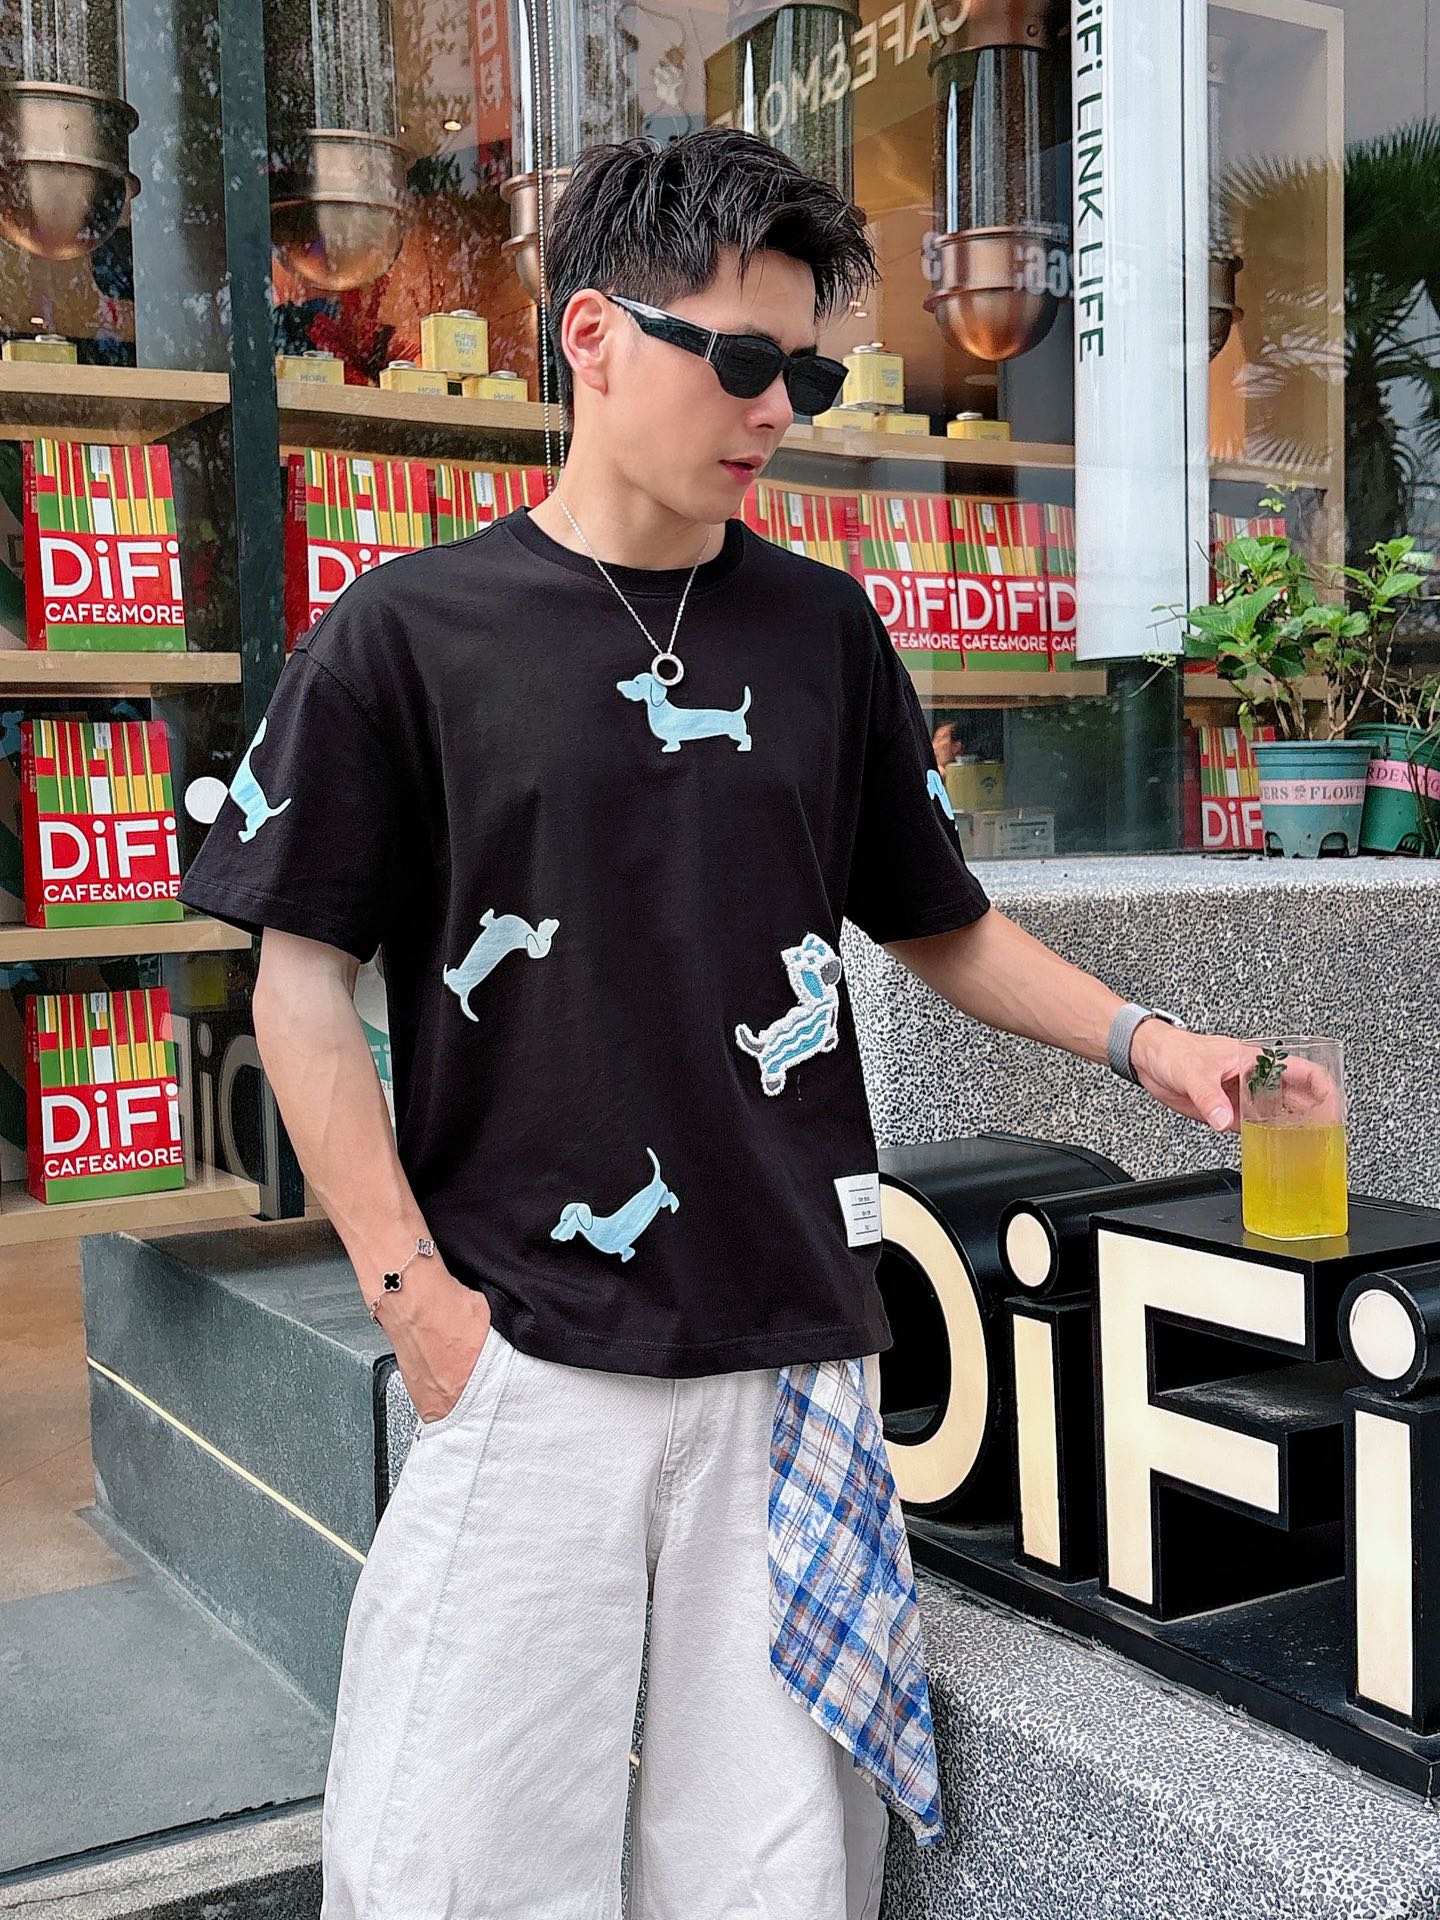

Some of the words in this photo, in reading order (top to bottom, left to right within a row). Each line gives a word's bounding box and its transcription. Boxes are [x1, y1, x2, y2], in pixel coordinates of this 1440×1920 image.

[1077, 91, 1103, 228] LINK
[1078, 241, 1104, 363] LIFE
[40, 537, 183, 600] DiFi
[45, 603, 184, 624] CAFE&MORE
[863, 574, 960, 630] DiFi
[957, 578, 1048, 632] DiFi
[961, 634, 1048, 651] CAFE&MORE
[39, 817, 180, 880] DiFi
[44, 880, 181, 902] CAFE&MORE
[41, 1083, 181, 1155] DiFi
[45, 1146, 183, 1177] CAFE&MORE
